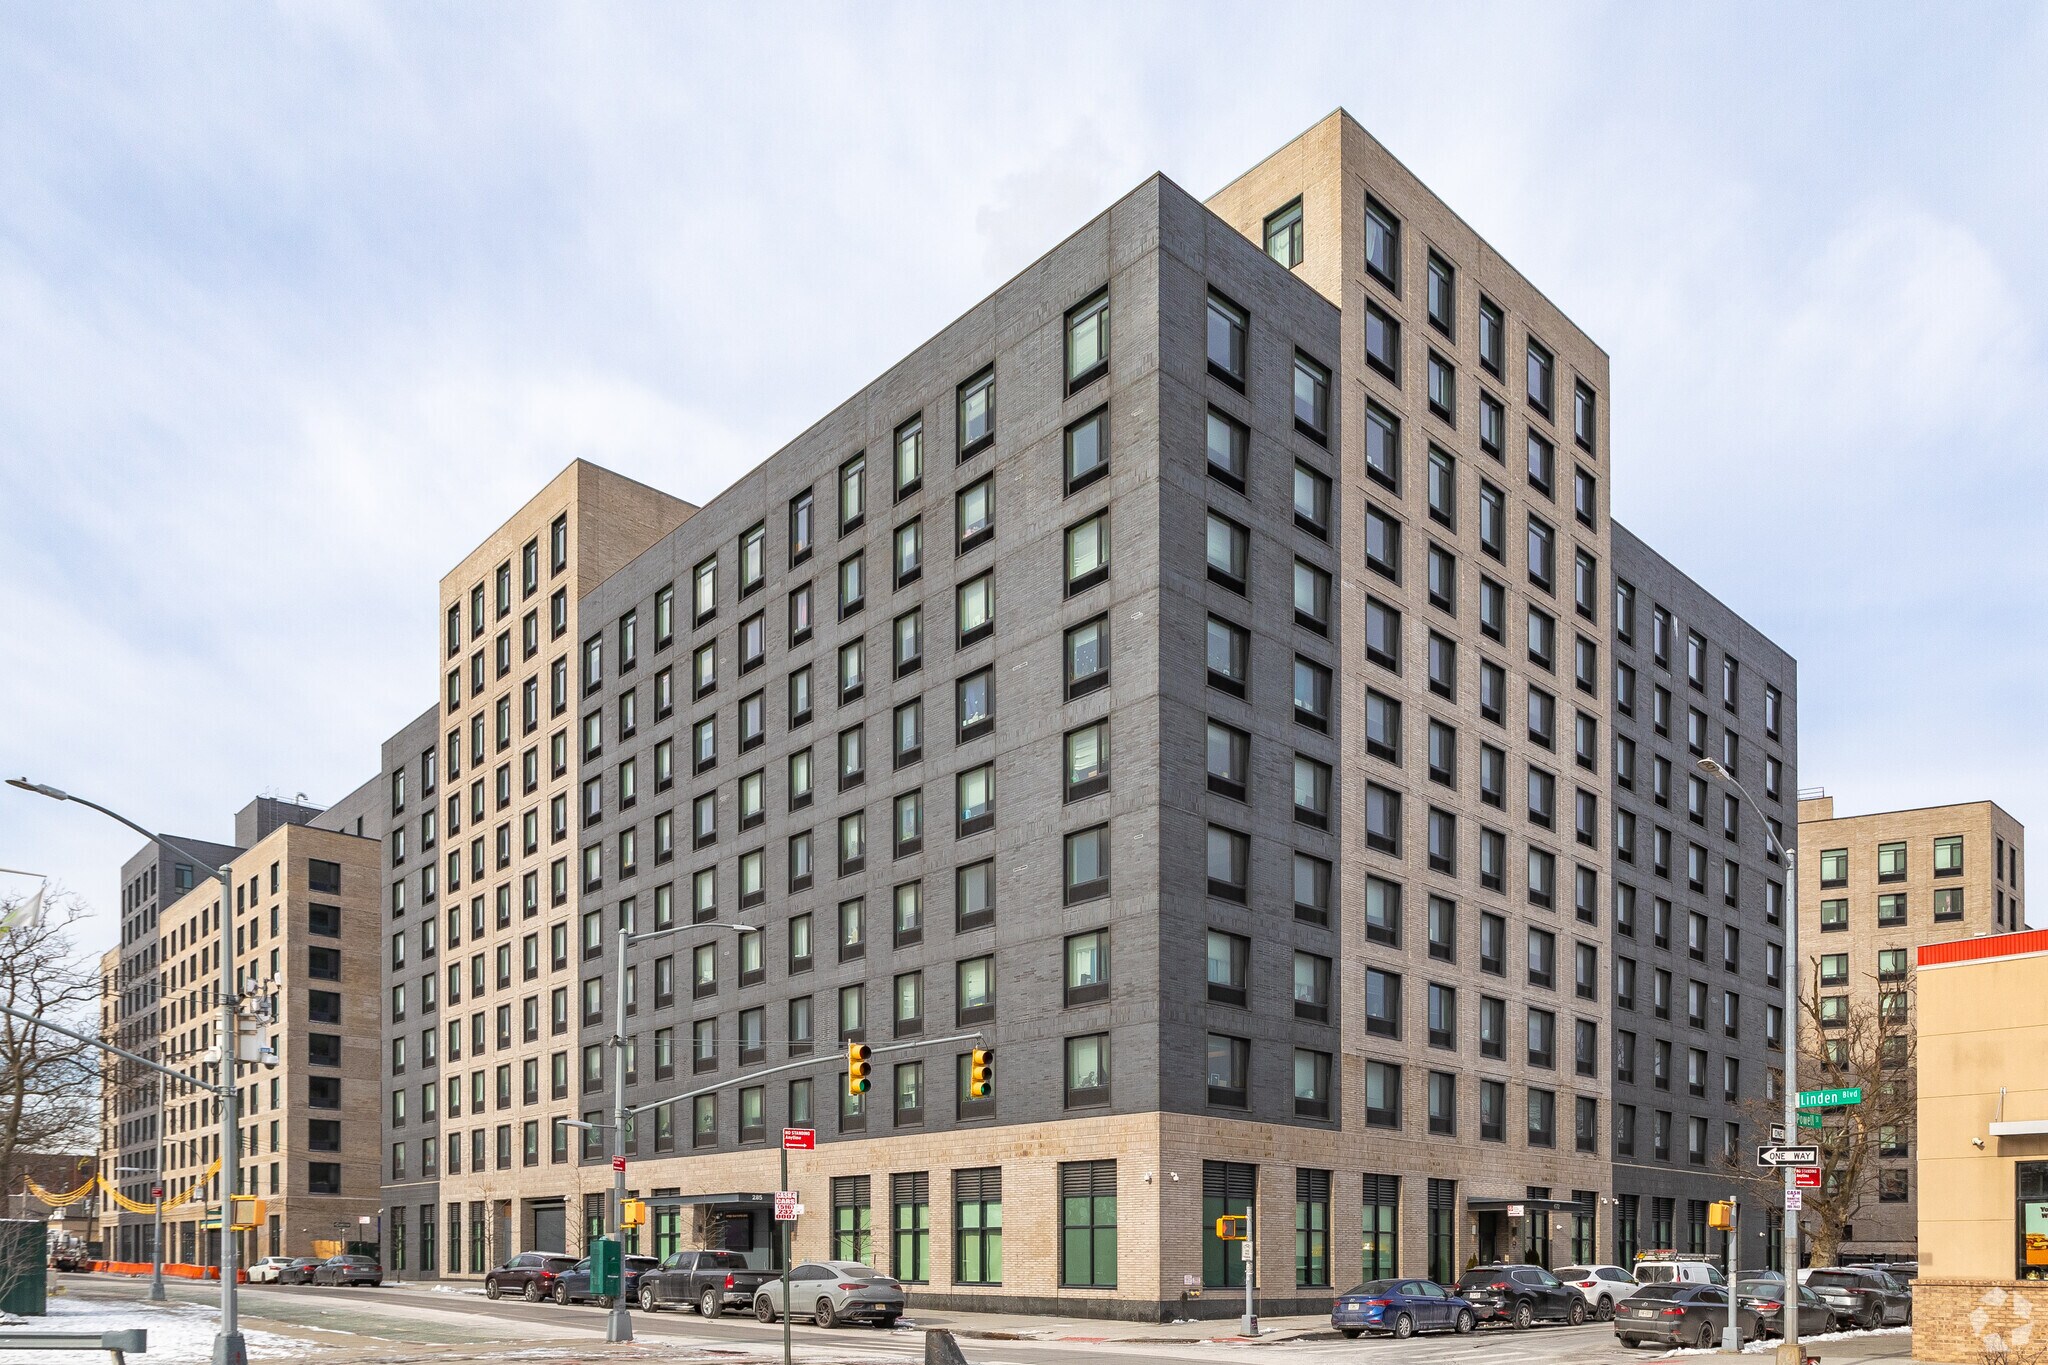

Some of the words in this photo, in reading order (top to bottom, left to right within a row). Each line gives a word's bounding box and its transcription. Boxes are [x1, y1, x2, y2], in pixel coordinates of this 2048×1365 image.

[1801, 1093, 1838, 1105] Linden
[1842, 1090, 1858, 1098] Blvd
[1793, 1152, 1811, 1160] WAY
